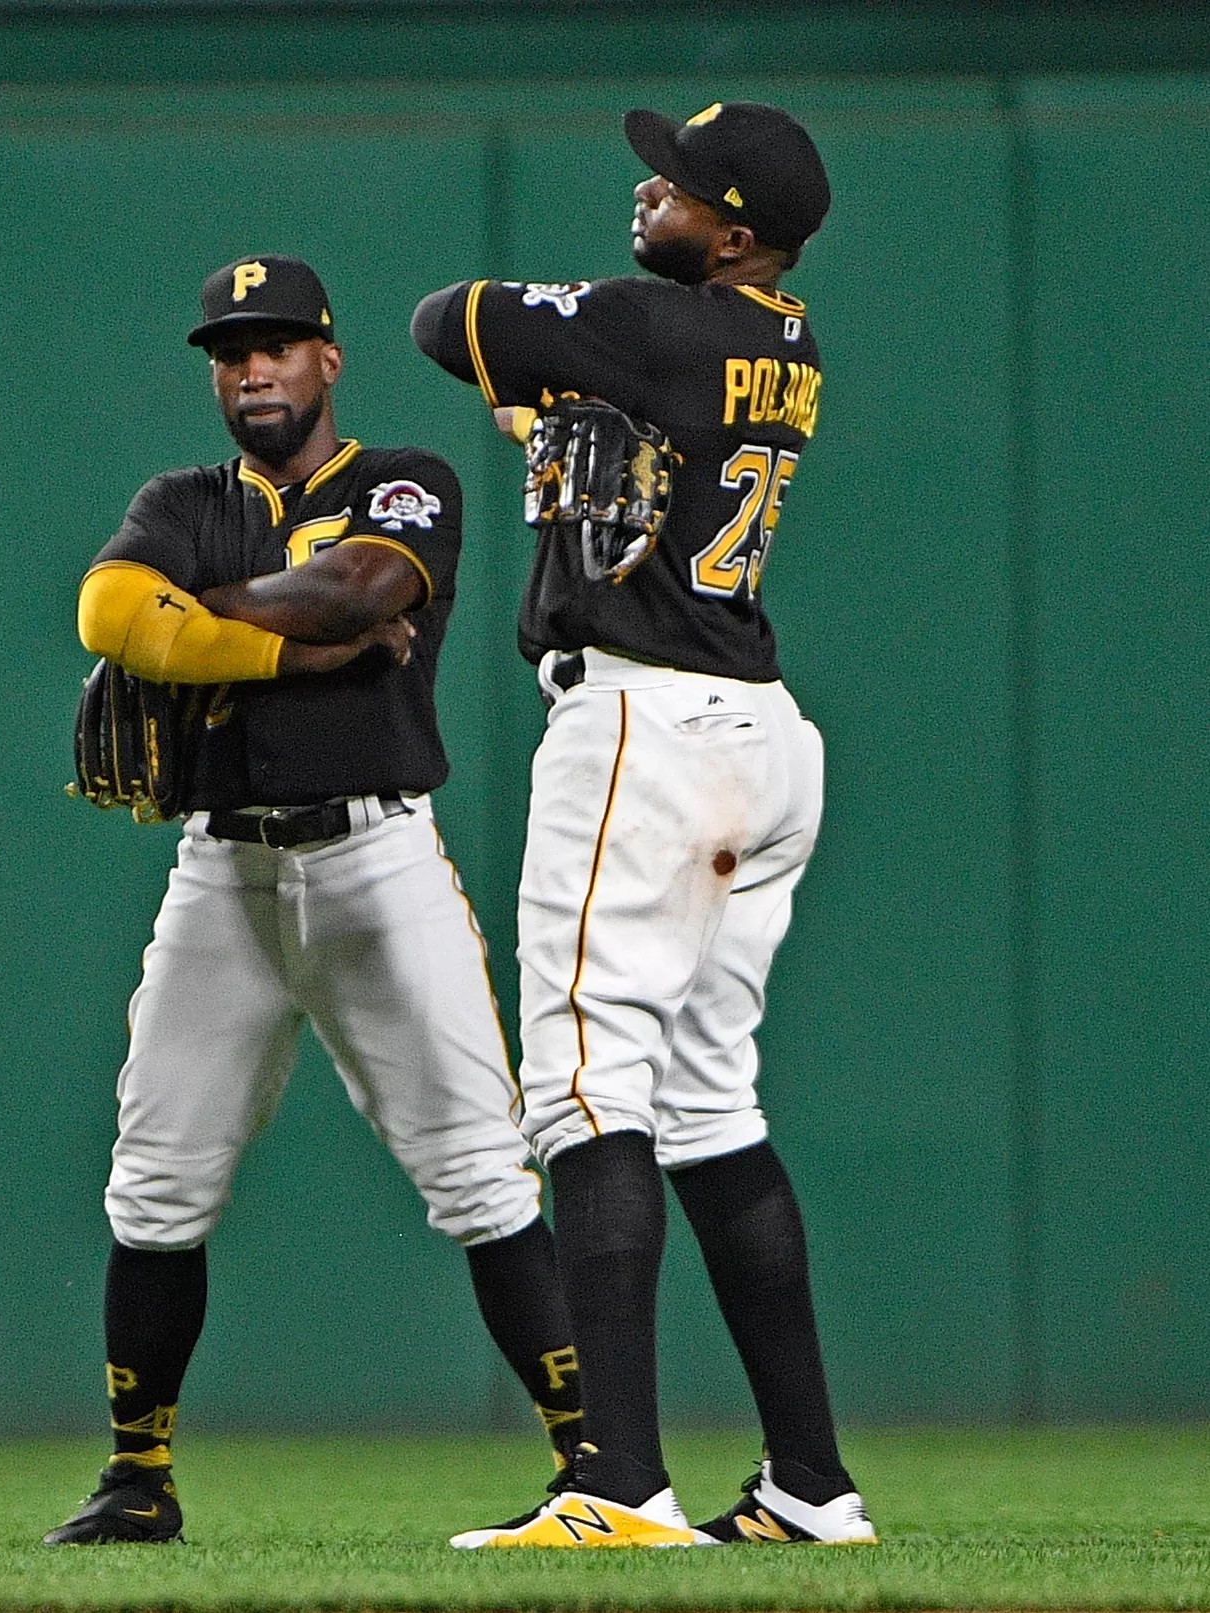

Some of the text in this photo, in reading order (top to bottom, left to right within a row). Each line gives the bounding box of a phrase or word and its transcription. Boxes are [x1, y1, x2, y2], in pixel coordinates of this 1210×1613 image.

[232, 260, 268, 302] P
[691, 444, 800, 599] 25
[106, 1362, 138, 1399] P
[554, 1502, 615, 1544] N
